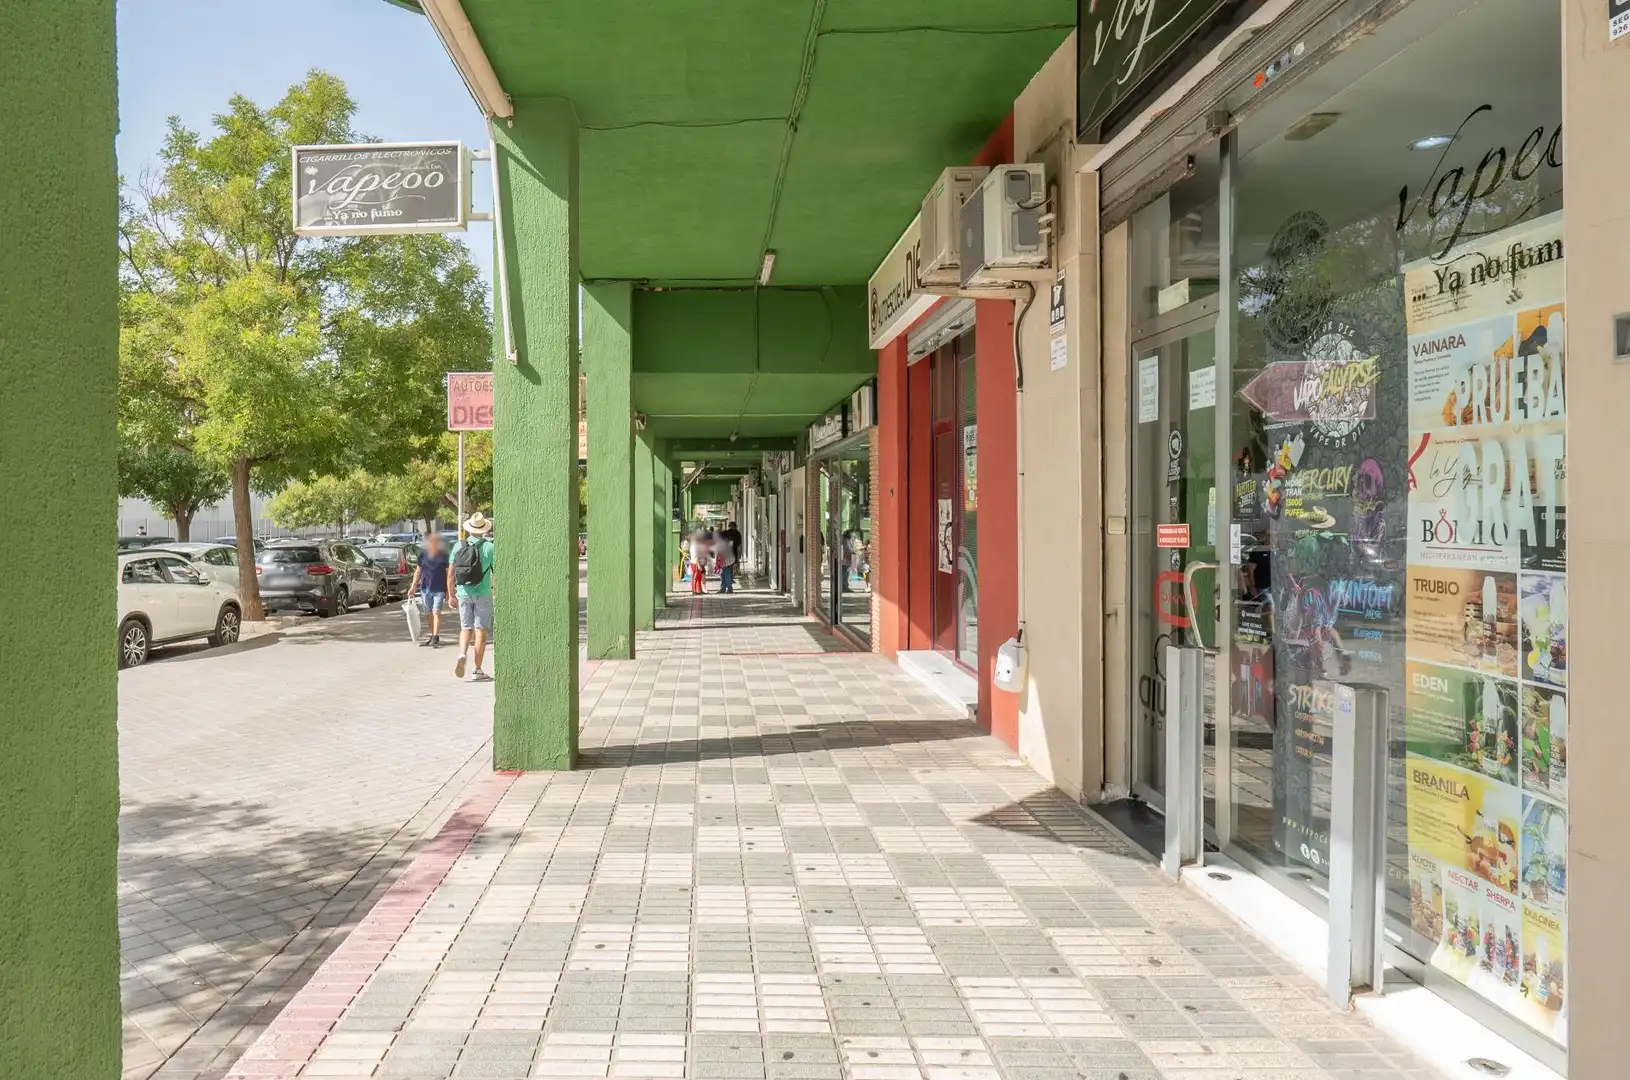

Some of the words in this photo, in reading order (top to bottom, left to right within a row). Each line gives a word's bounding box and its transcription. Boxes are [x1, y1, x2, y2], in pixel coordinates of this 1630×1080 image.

[299, 152, 369, 163] CIGARRILLOS
[371, 208, 403, 222] fumo
[1413, 333, 1467, 357] VAINARA
[1455, 354, 1566, 429] PRUEBA
[1413, 578, 1460, 596] TRUBIO
[1412, 672, 1449, 694] EDEN
[1413, 769, 1470, 801] BRANILA
[1448, 869, 1479, 892] NECTAR
[1485, 887, 1517, 912] SHERPA
